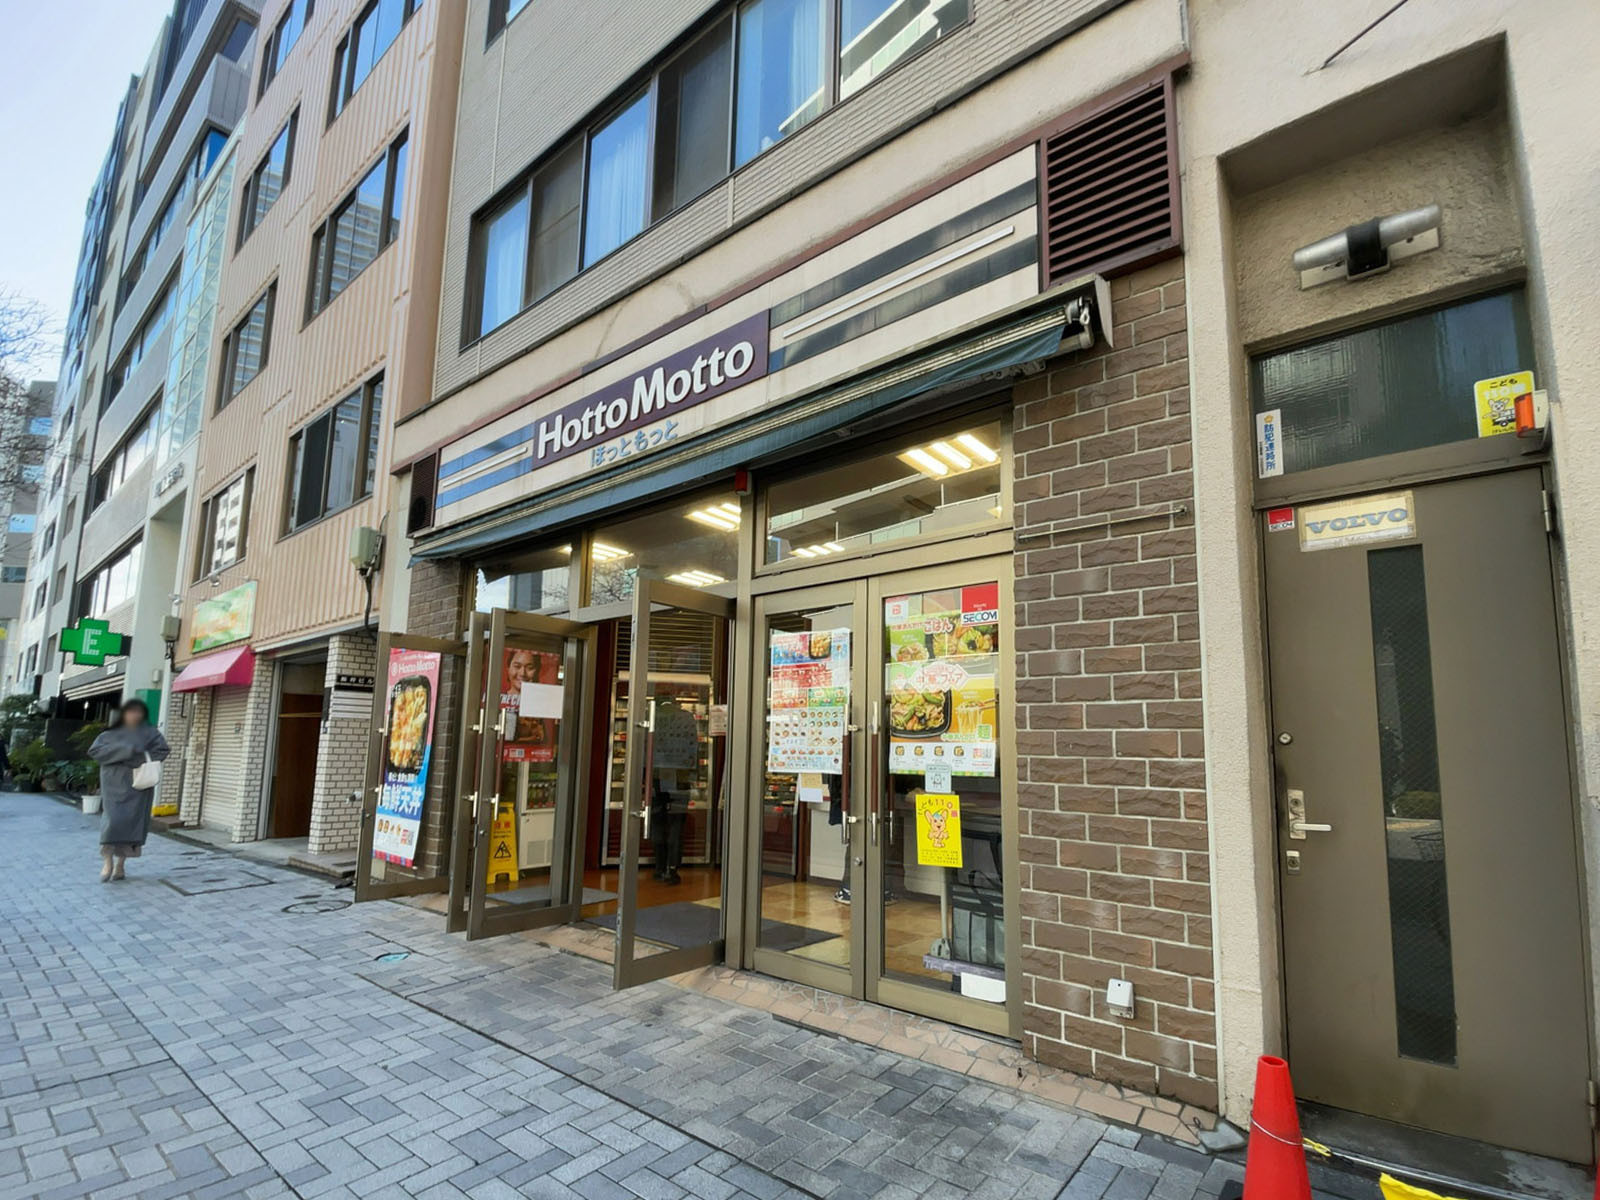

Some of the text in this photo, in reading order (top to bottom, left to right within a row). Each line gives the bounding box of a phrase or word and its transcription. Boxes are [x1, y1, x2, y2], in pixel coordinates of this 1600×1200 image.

[1490, 379, 1518, 389] こども
[590, 420, 679, 467] ほっともっと
[1264, 424, 1276, 471] 防犯連絡所
[1306, 508, 1408, 534] VOLVO
[963, 611, 998, 623] SECOM
[82, 628, 102, 655] E
